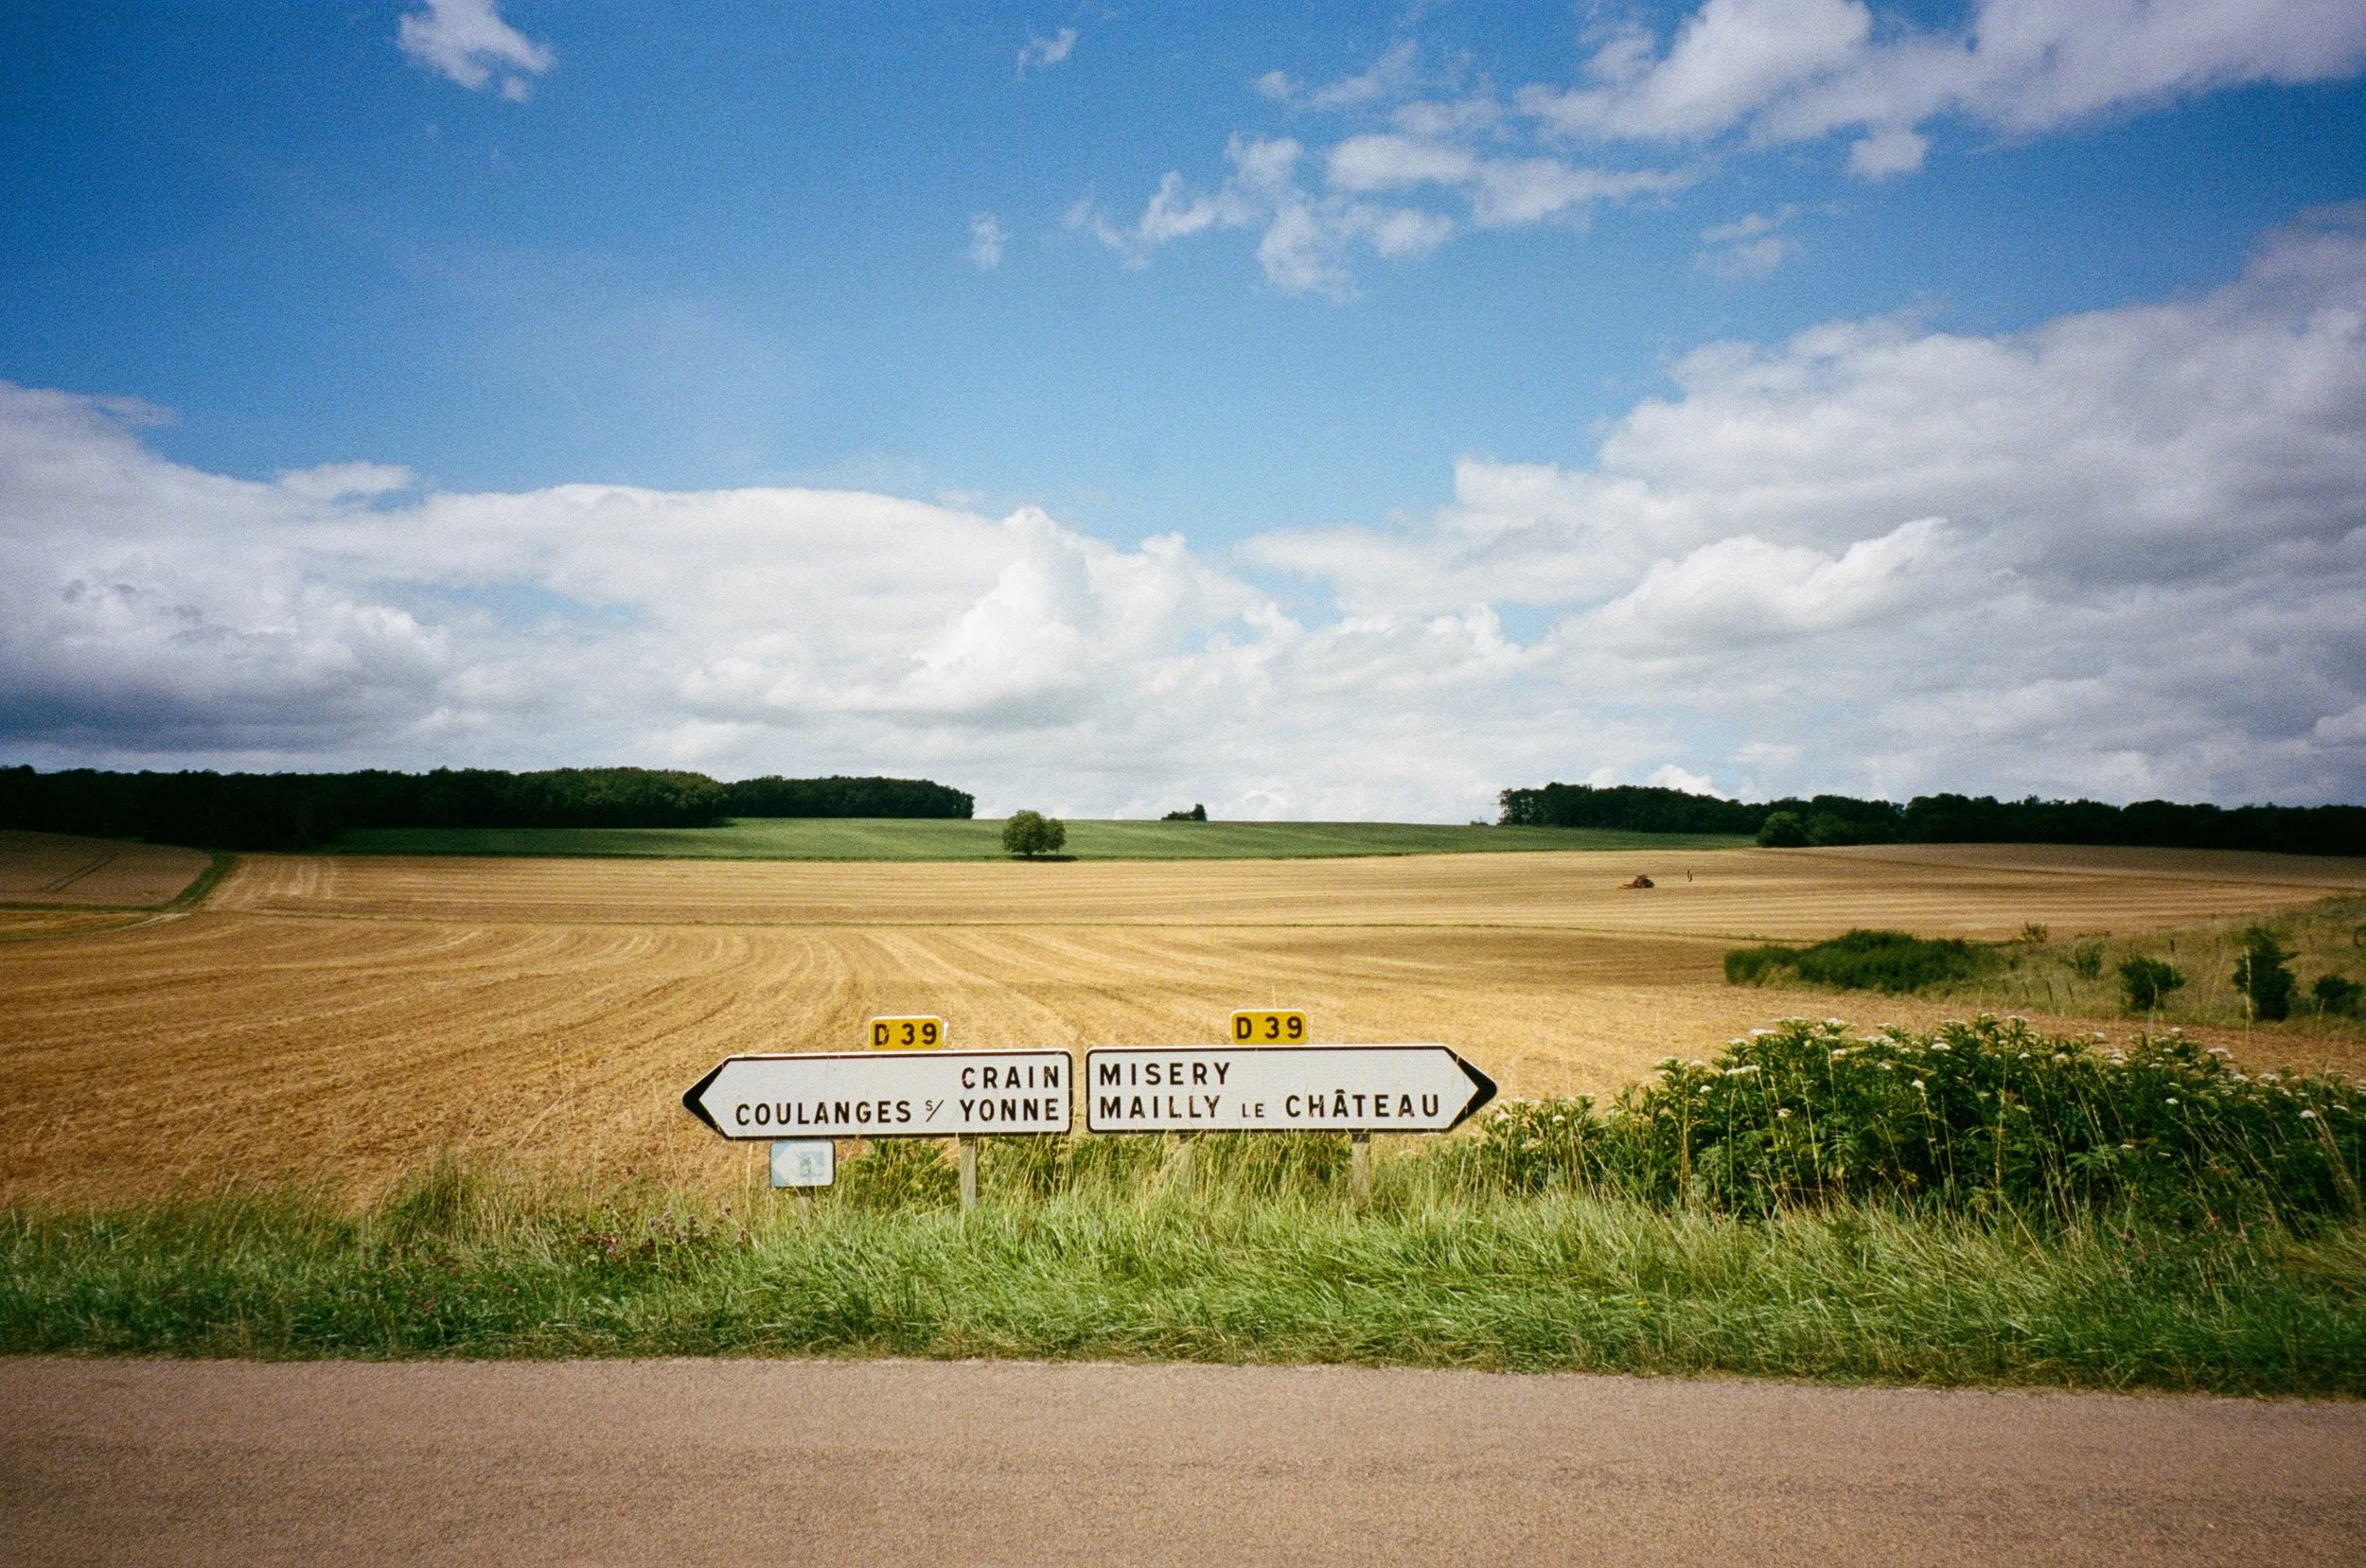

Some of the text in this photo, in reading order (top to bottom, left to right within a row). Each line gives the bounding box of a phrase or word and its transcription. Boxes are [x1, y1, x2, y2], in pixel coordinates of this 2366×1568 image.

[874, 1022, 937, 1046] D 39
[1236, 1015, 1302, 1040] D 39
[962, 1066, 1059, 1089] CRAIN
[1100, 1062, 1230, 1086] MISERY
[735, 1100, 911, 1126] COULANGES
[959, 1098, 1059, 1122] YONNE
[1100, 1088, 1439, 1119] MAILLY LE CHÂTEAU
